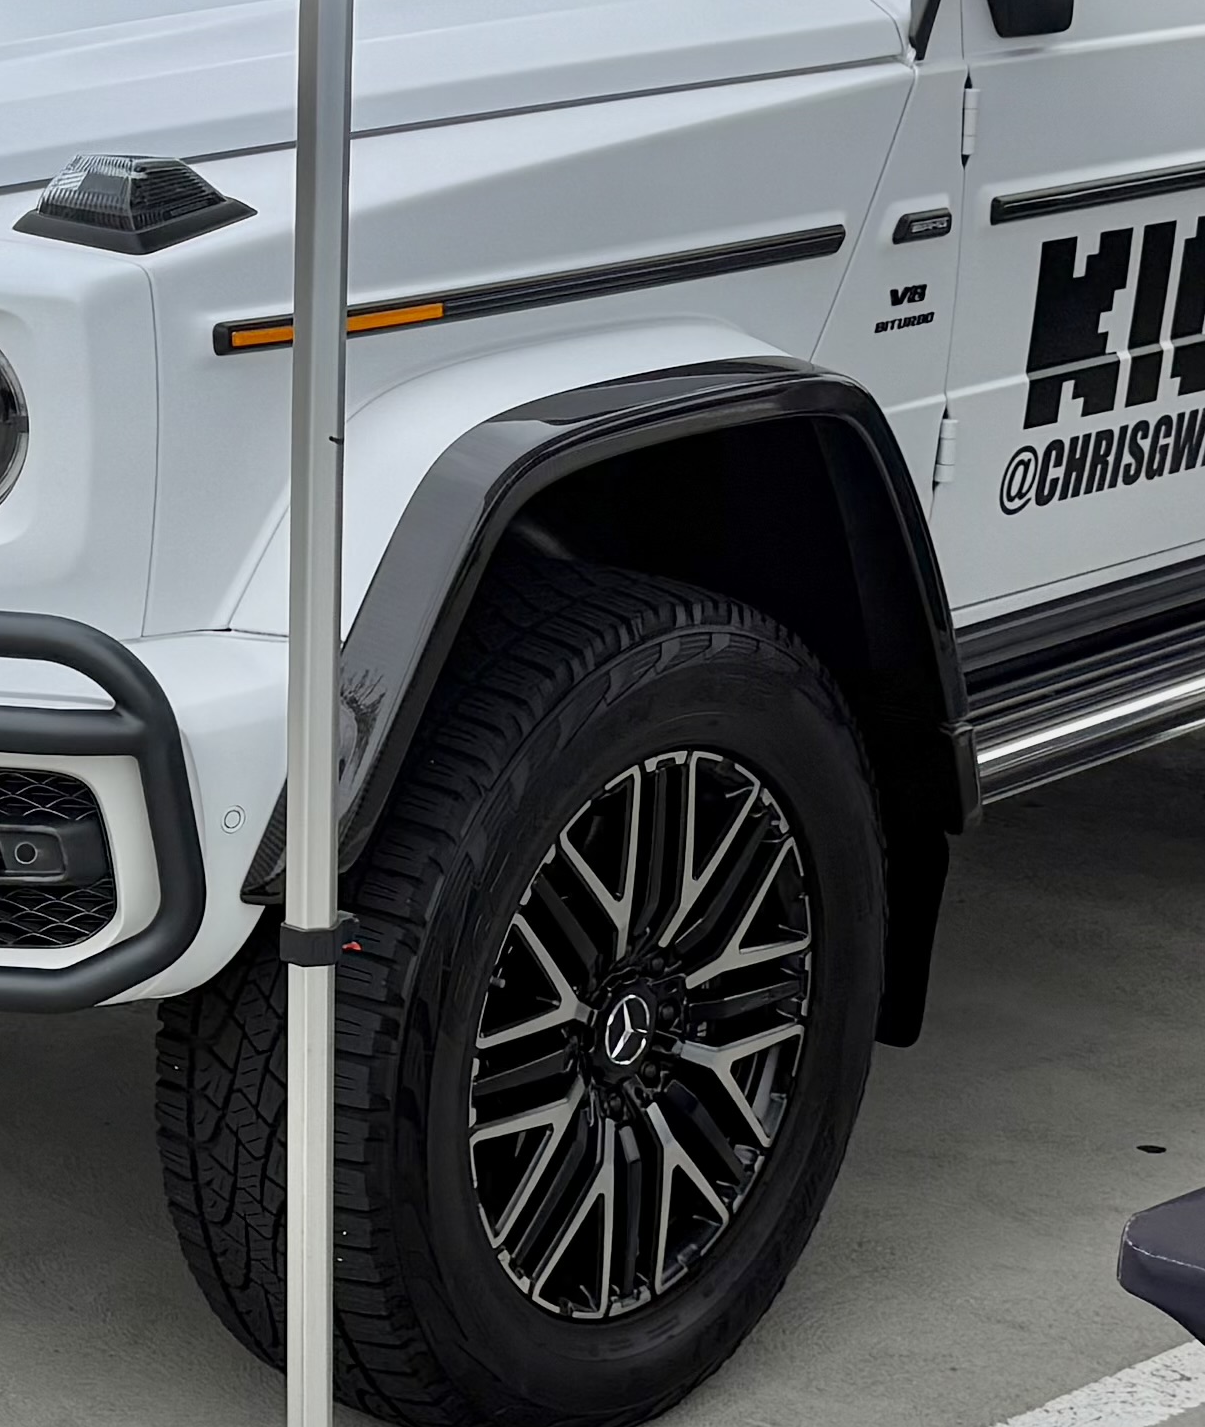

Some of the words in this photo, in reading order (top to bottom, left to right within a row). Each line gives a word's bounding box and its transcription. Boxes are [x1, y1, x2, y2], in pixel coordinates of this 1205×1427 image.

[889, 283, 928, 307] V8
[874, 311, 935, 334] BITURBO
[999, 407, 1205, 515] @CHRISGW
